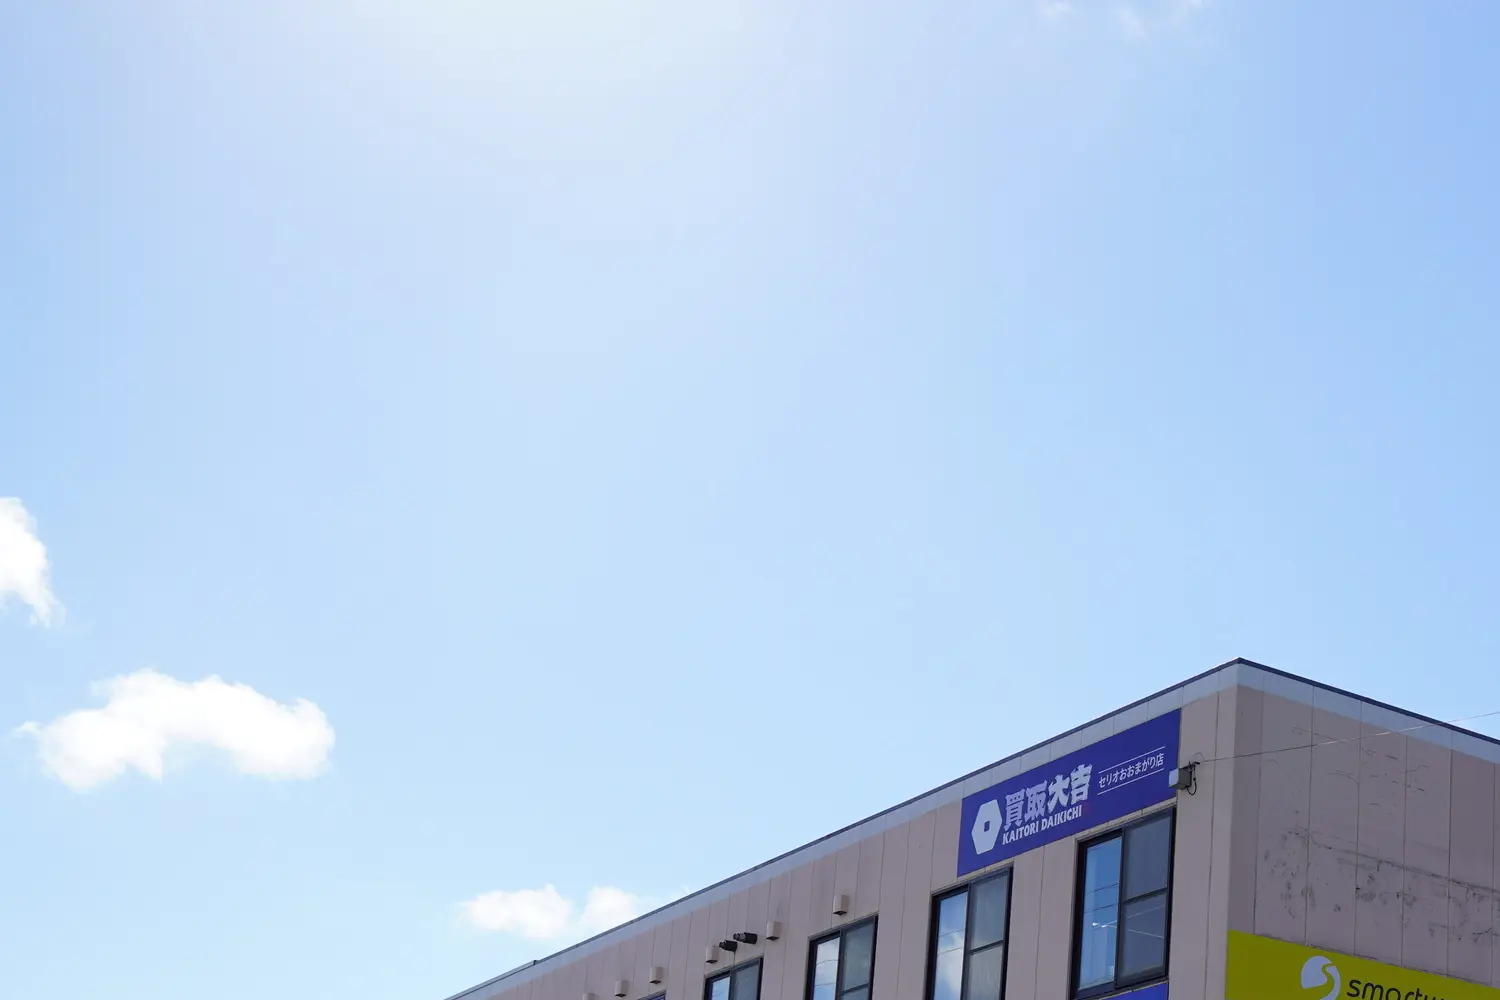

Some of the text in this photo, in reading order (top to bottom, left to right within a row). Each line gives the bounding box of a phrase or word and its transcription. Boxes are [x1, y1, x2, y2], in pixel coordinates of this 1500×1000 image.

[1099, 752, 1165, 789] セリオおおまがり店
[1003, 764, 1093, 831] 買取大吉
[1002, 804, 1083, 846] KAITORI DAIKICHI
